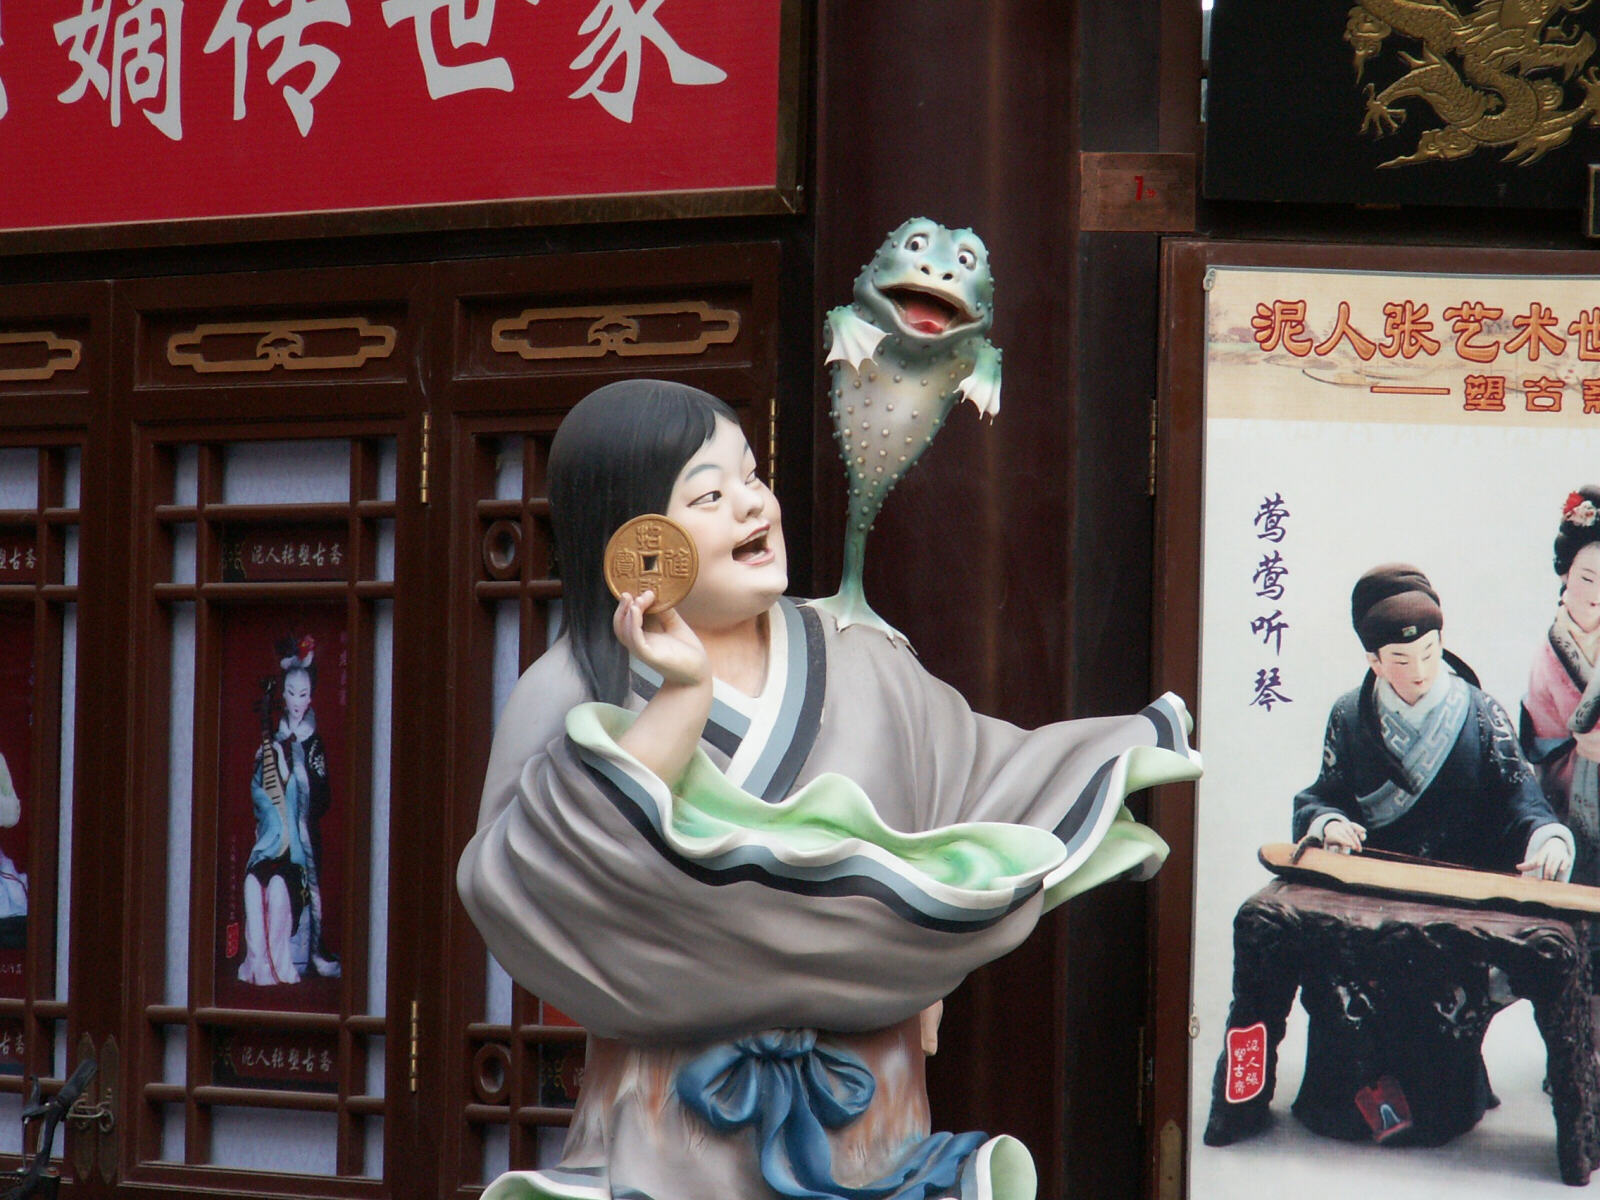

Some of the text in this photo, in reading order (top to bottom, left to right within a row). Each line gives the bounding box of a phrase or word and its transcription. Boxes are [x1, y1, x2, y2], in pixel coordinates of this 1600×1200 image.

[0, 0, 728, 140] 嫡传世家
[1249, 492, 1293, 712] 莺莺听琴
